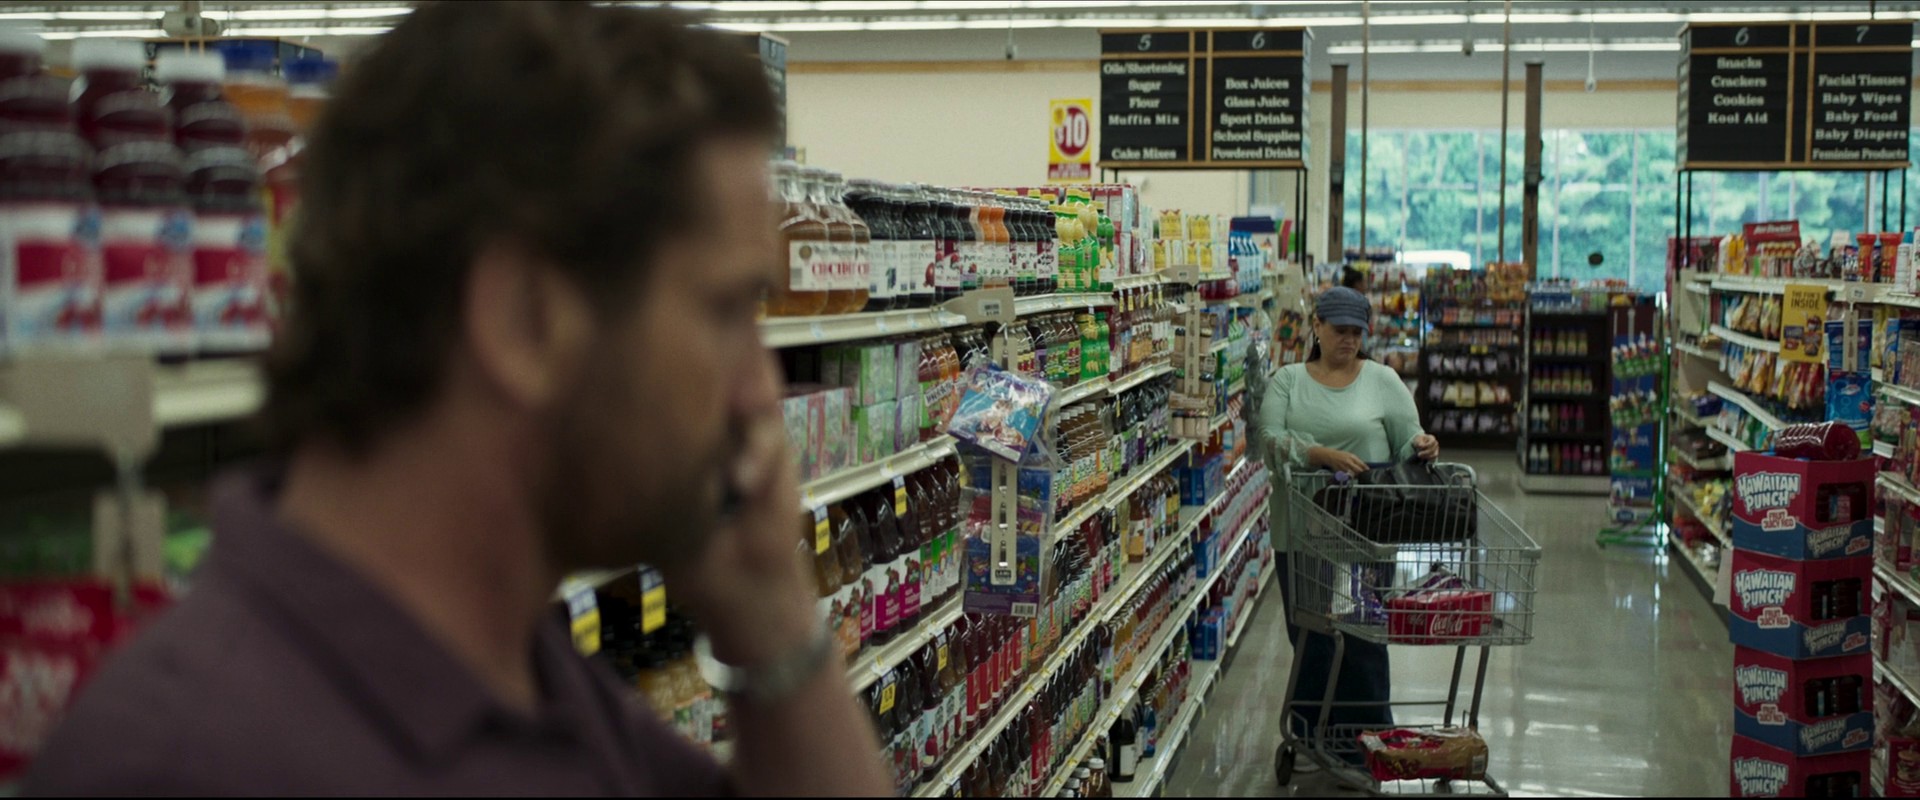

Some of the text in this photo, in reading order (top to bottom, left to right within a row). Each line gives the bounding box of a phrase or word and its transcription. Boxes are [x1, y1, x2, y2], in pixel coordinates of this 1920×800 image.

[1251, 32, 1265, 49] 6
[1735, 27, 1749, 46] 6
[1856, 26, 1869, 43] 7
[1138, 33, 1152, 51] 5
[1103, 62, 1186, 75] Oils/Shortening
[1716, 57, 1763, 70] Snacks
[1128, 79, 1162, 92] Sugar
[1225, 78, 1290, 90] Box Juices
[1711, 75, 1768, 88] Crackers
[1818, 74, 1907, 87] Facial Tissues
[1129, 97, 1161, 109] Flour
[1224, 96, 1290, 108] Glass Juice
[1713, 94, 1765, 107] Cookies
[1822, 92, 1903, 106] Baby Wipes
[1108, 114, 1180, 126] Muffin Mix
[1220, 113, 1295, 126] Sport Drinks
[1708, 112, 1769, 124] Kool Aid
[1825, 110, 1898, 124] Baby Food
[1213, 130, 1301, 143] School Supplies
[1815, 128, 1907, 142] Baby Diapers
[1111, 147, 1177, 160] Cake Mixes
[1213, 147, 1300, 159] Powdered Drinks
[1812, 148, 1907, 160] Feminine Products
[1790, 298, 1820, 310] INSIDE
[1737, 472, 1799, 497] HAWAIIAN
[1746, 490, 1788, 513] PUNCH
[1808, 526, 1850, 545] HAWAIIAN
[1815, 537, 1844, 557] PUNCH
[1735, 570, 1795, 594] HAWAIIAN
[1743, 588, 1783, 611] PUNCH
[1805, 623, 1846, 643] HAWAIIAN
[1811, 632, 1840, 654] PUNCH
[1736, 666, 1787, 689] HAWAIIAN
[1744, 686, 1778, 706] PUNCH
[1802, 721, 1846, 741] HAWAIIAN
[1735, 758, 1788, 781] HAWAIIAN
[1742, 778, 1778, 797] PUNCH
